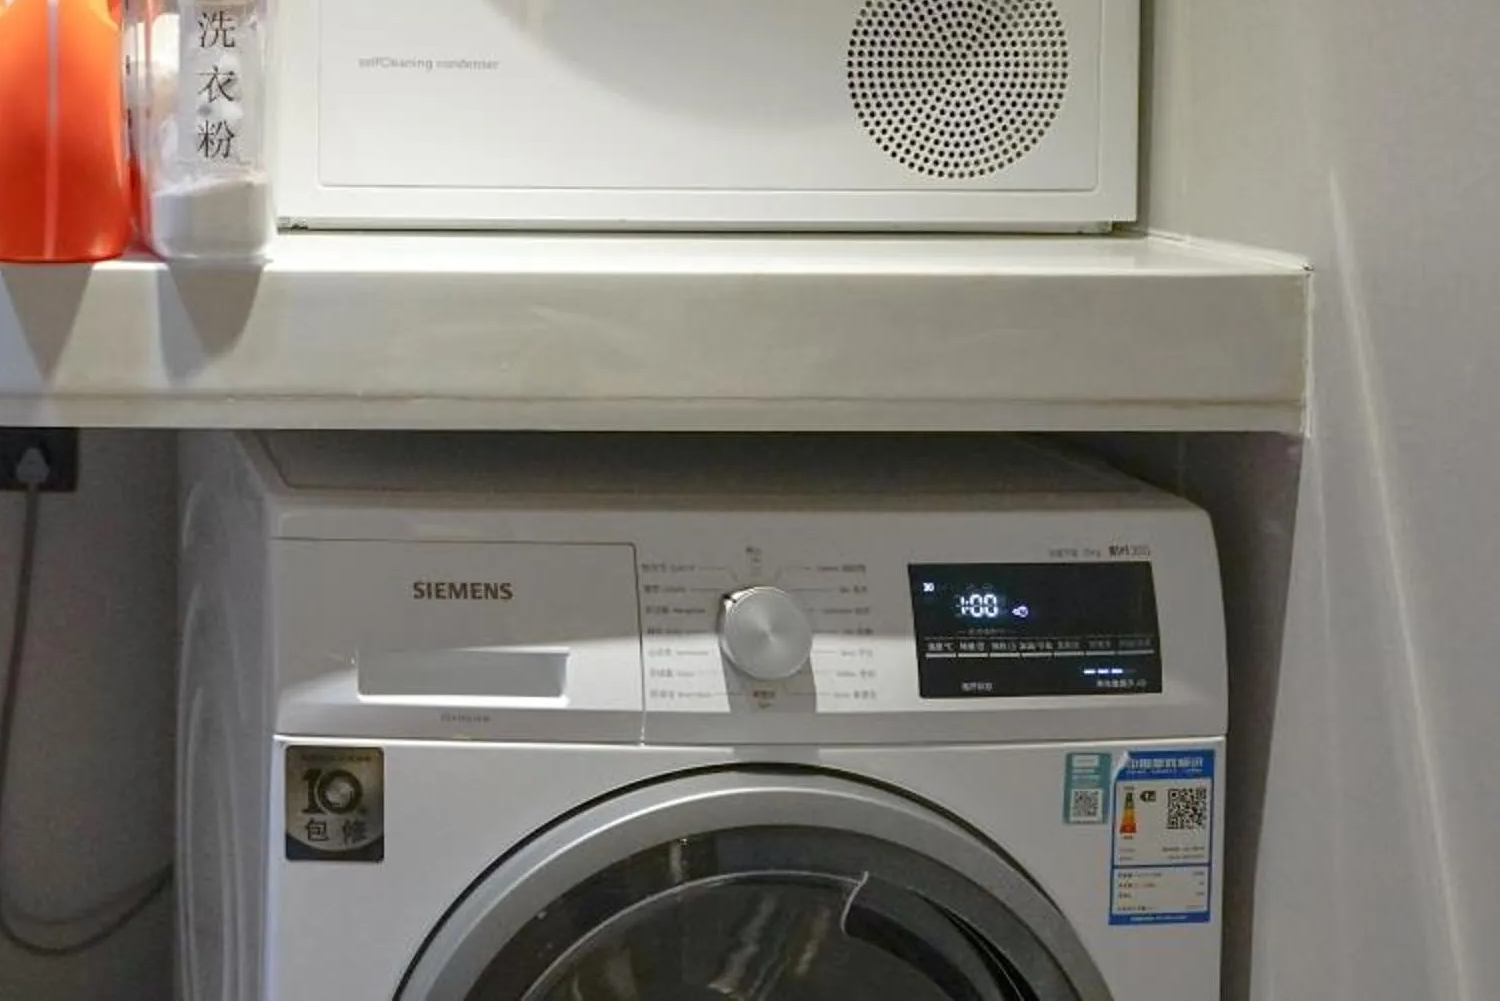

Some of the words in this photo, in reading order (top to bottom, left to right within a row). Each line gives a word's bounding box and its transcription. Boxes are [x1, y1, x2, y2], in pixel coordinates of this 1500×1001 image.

[197, 10, 237, 159] 洗衣粉
[412, 581, 514, 601] SIEMENS
[960, 593, 999, 618] 1:00
